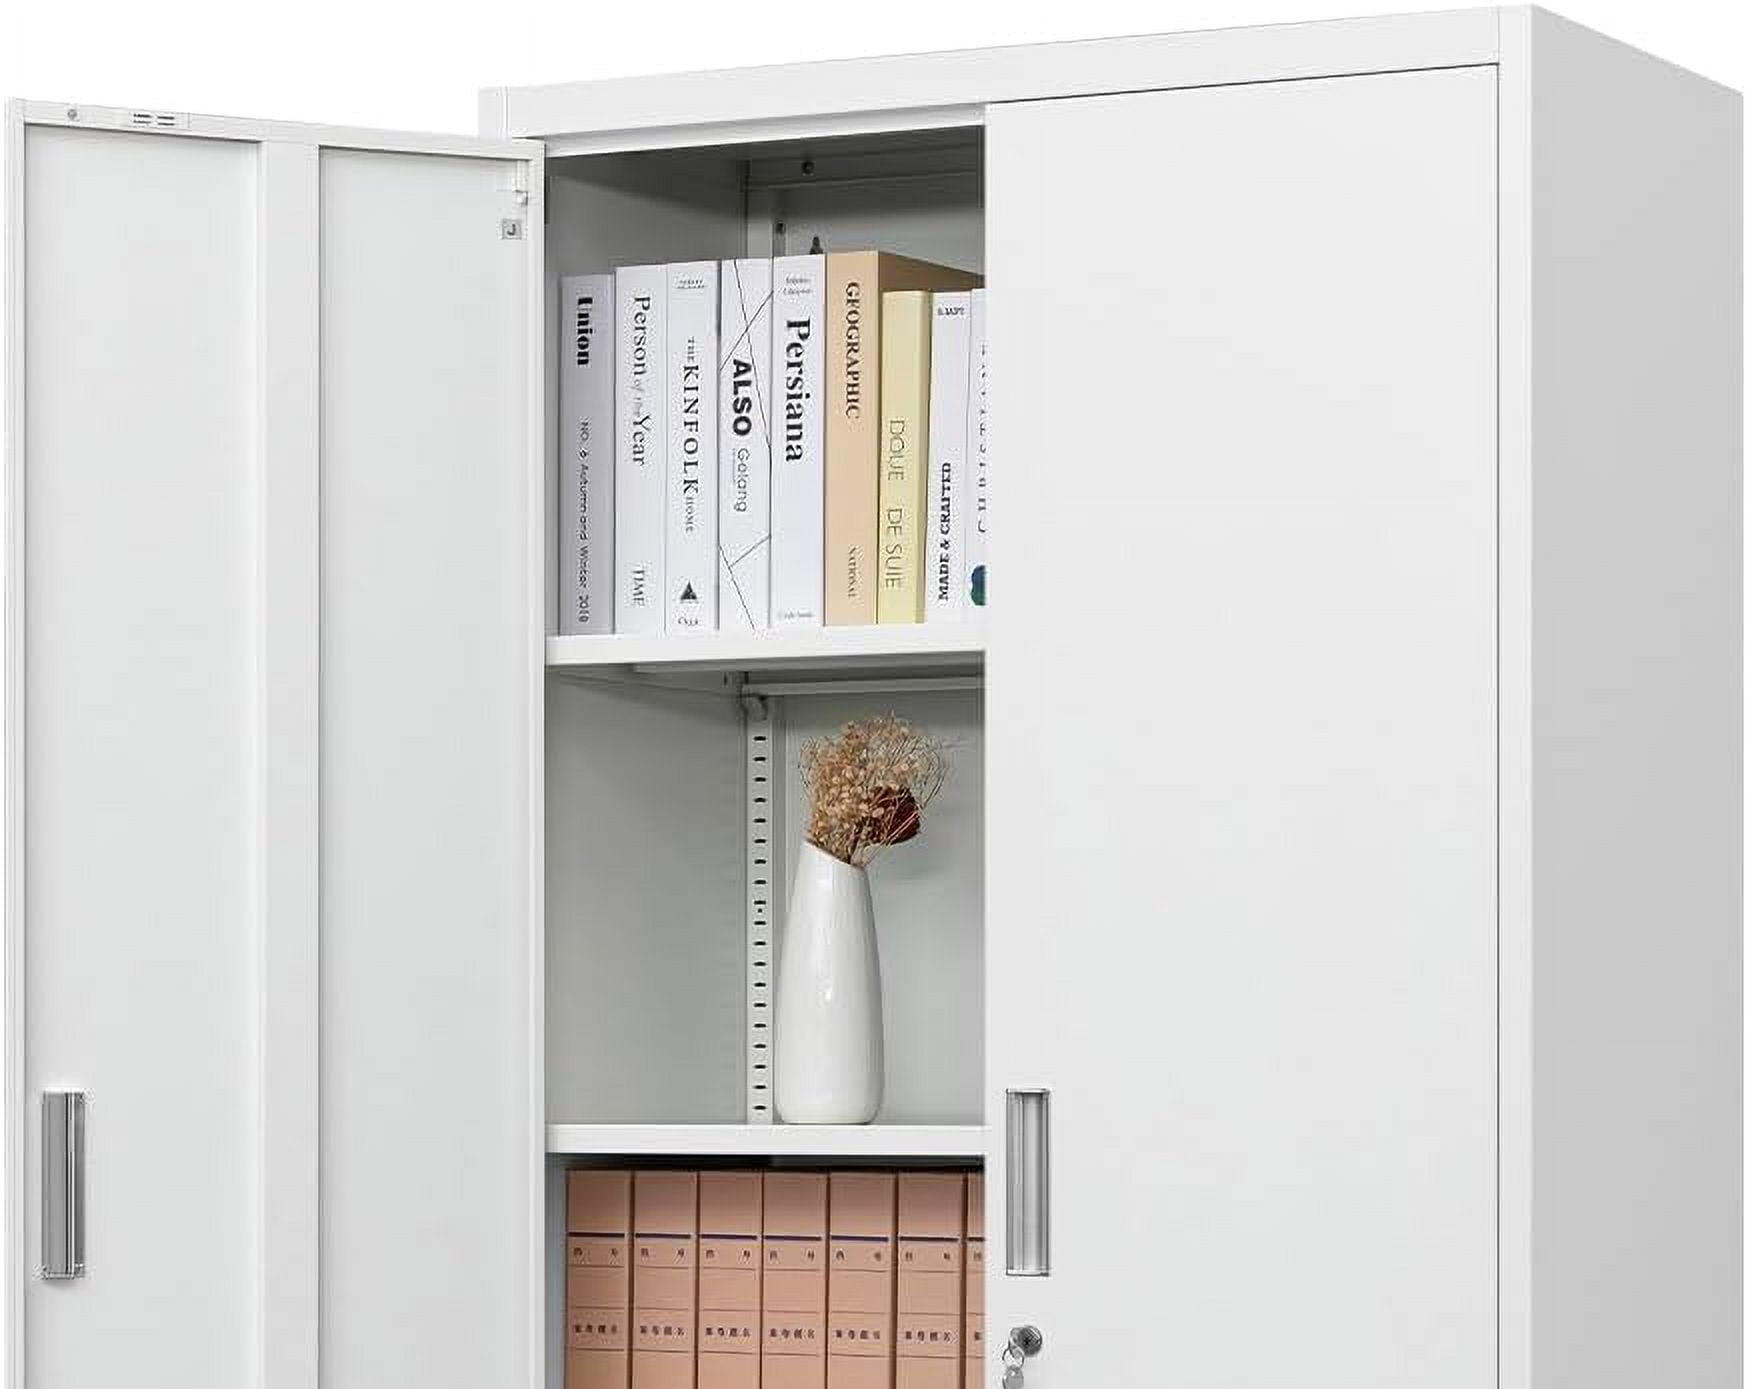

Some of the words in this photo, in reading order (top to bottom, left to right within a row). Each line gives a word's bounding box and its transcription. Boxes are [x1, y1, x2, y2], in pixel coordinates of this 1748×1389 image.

[577, 297, 593, 365] Union
[634, 297, 650, 375] Person
[845, 282, 860, 419] GEOGRAPHIC
[733, 358, 752, 436] ALSO
[786, 318, 810, 461] Persiana
[633, 414, 651, 465] Year
[684, 365, 699, 494] KINFOLK
[734, 448, 751, 513] Golang
[887, 509, 902, 535] DE
[940, 540, 950, 551] &
[633, 569, 646, 606] TIME
[939, 553, 950, 601] MADE
